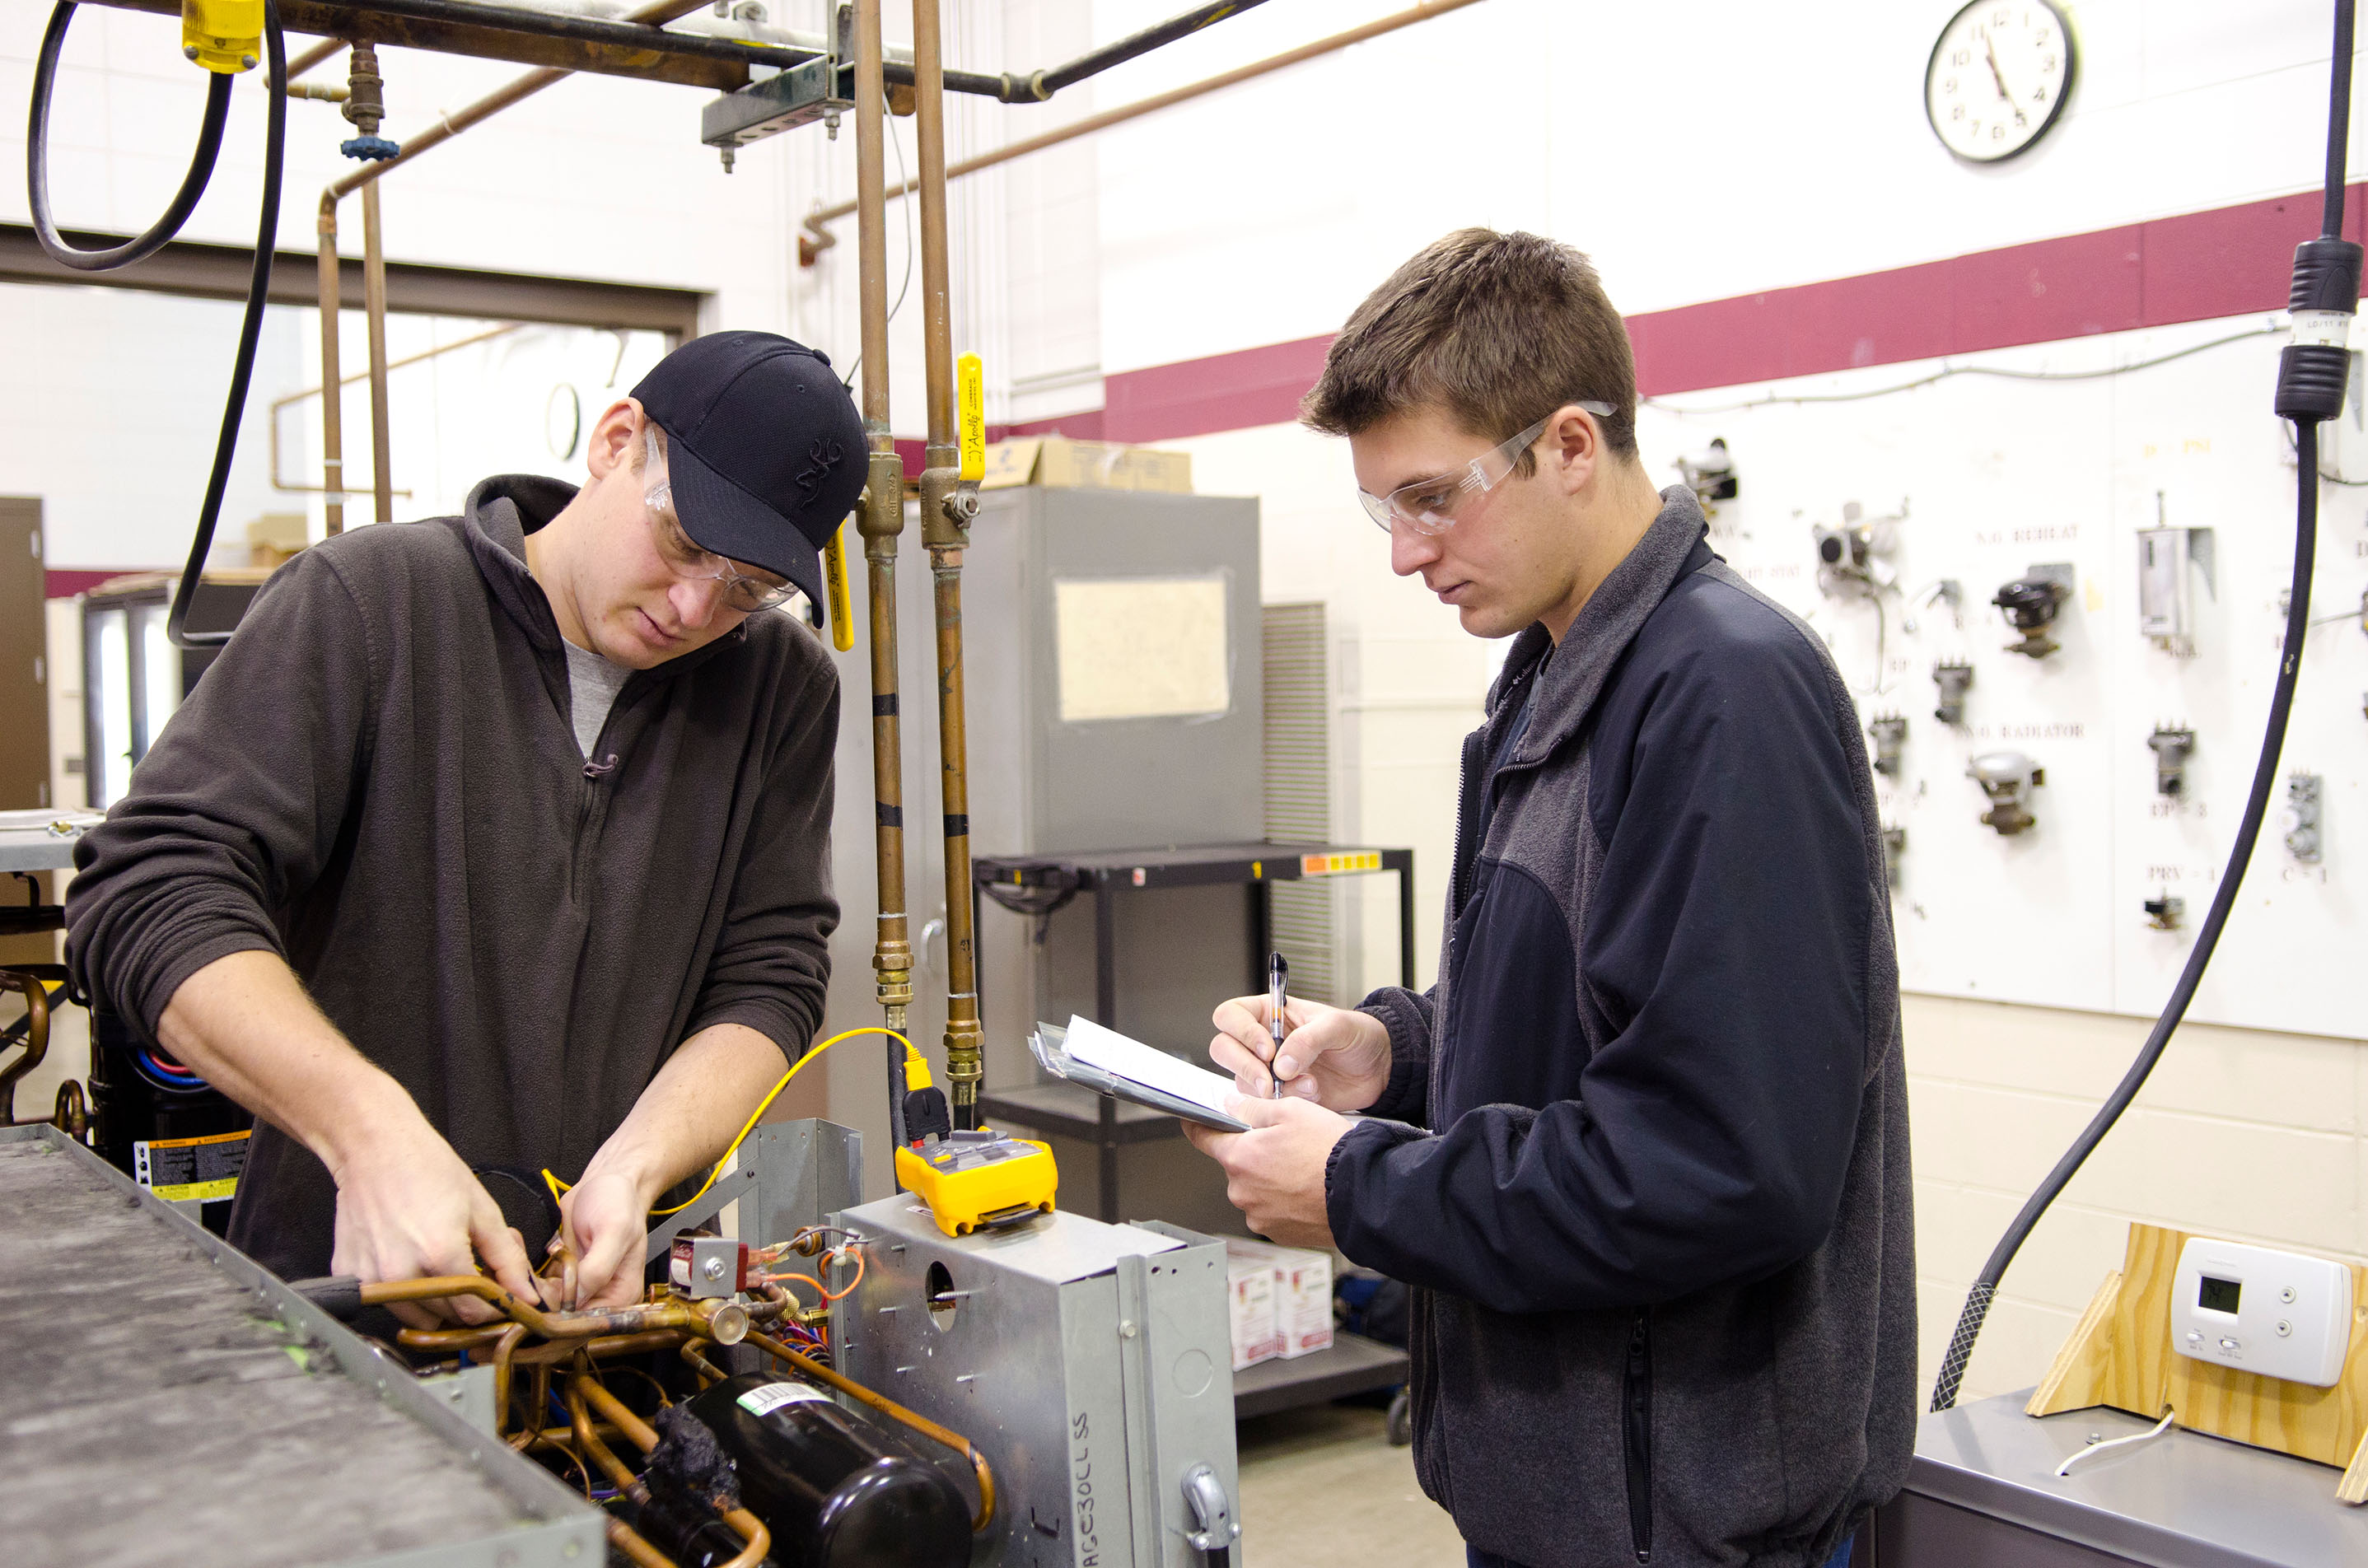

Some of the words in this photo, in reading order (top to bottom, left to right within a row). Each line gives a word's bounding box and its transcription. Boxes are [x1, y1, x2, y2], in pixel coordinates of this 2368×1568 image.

[1992, 9, 2011, 27] 12
[1971, 24, 1986, 40] 11
[2035, 28, 2049, 48] 2
[1951, 50, 1970, 68] 10
[2043, 54, 2056, 73] 3
[1944, 78, 1958, 94] 9
[2033, 85, 2046, 102] 4
[1971, 119, 1982, 138] 7
[1999, 721, 2085, 739] RADIATOR
